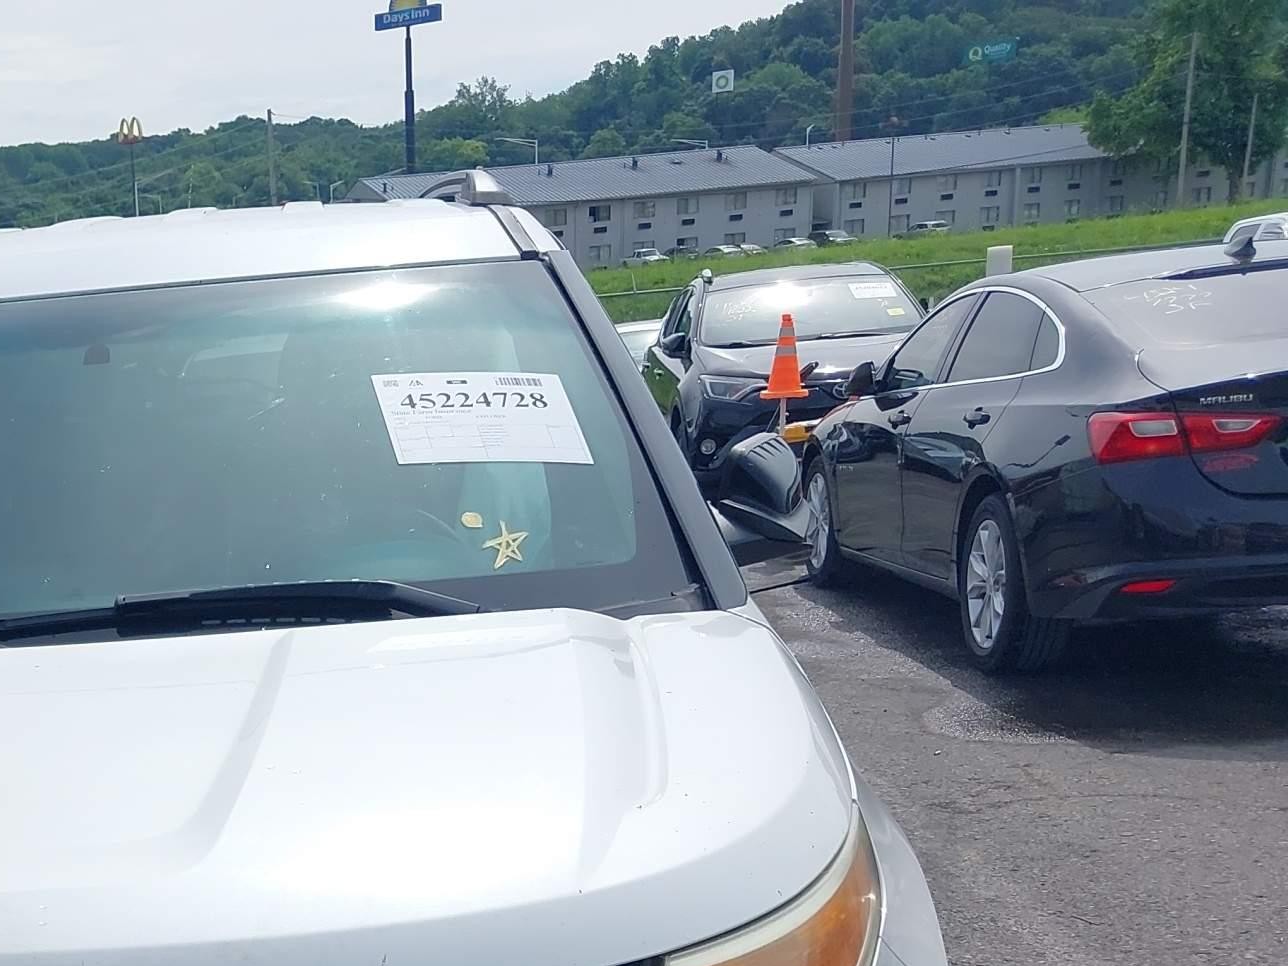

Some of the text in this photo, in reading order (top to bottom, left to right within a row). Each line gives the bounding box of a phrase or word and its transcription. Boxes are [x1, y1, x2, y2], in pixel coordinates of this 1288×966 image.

[383, 12, 409, 24] Days
[411, 8, 429, 19] Inn
[400, 391, 549, 409] 45224728
[1200, 394, 1253, 404] MALIBU
